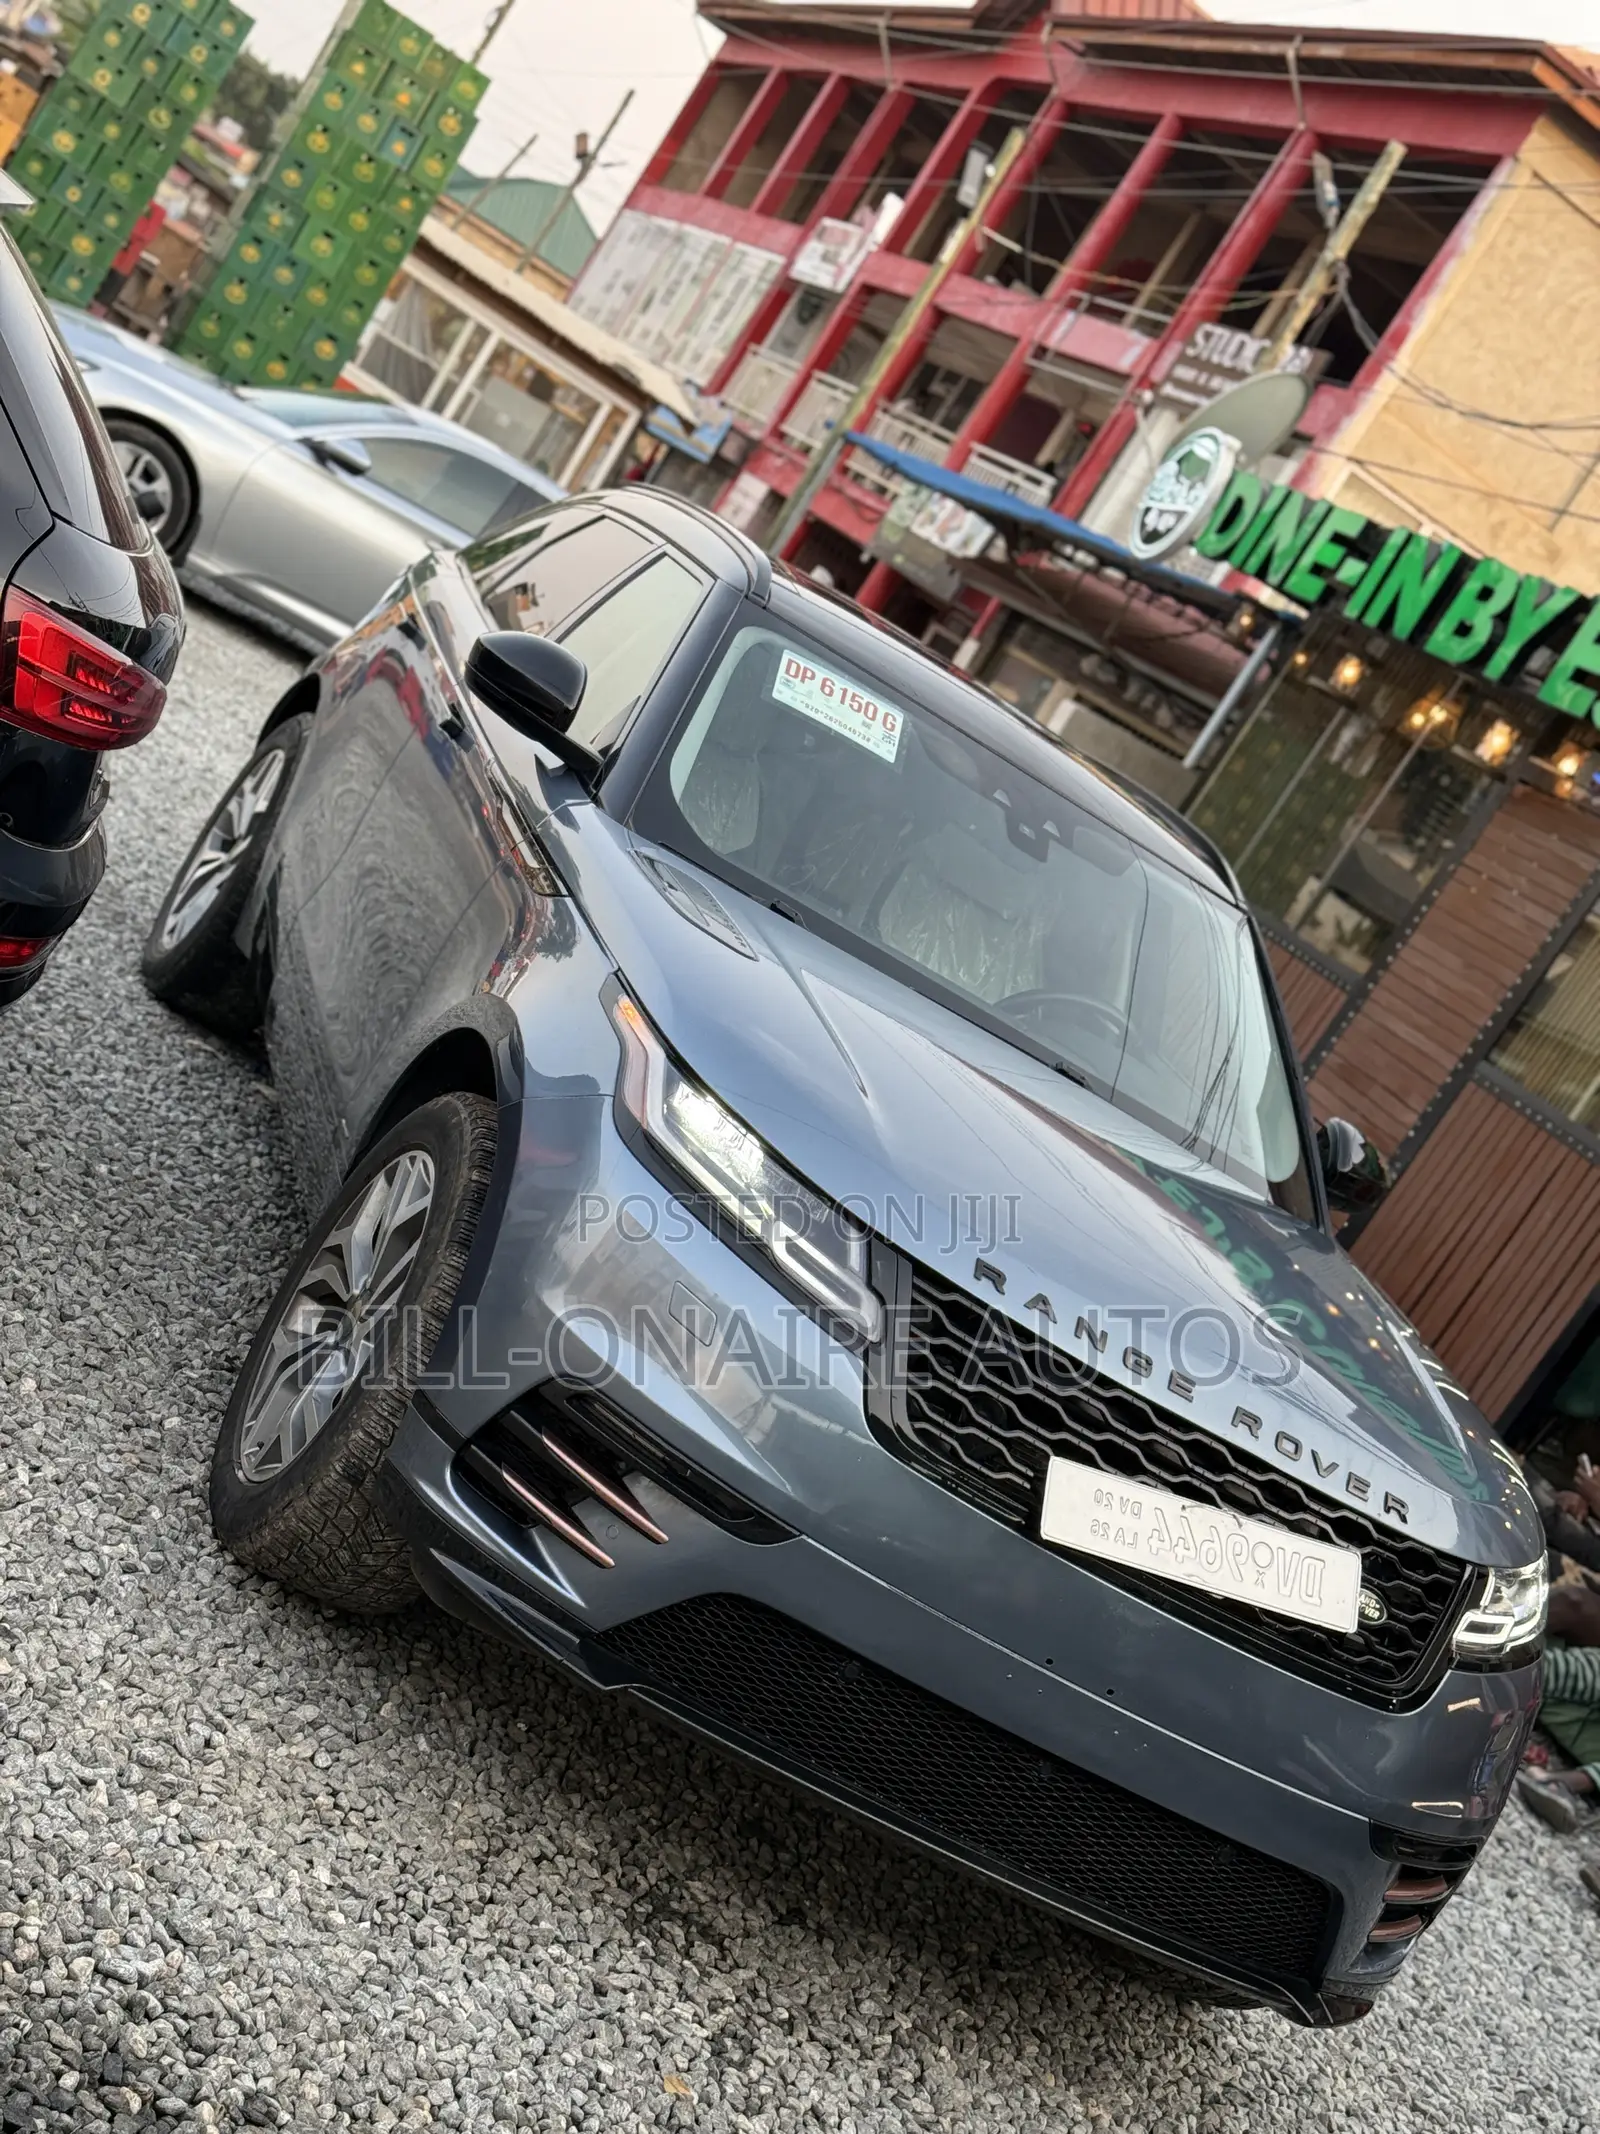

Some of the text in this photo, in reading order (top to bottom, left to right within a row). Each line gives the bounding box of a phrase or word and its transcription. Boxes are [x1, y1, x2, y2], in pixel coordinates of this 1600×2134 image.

[1195, 470, 1462, 641] DINE-IN
[1423, 557, 1581, 681] BY
[784, 658, 816, 684] DP
[820, 677, 879, 721] 6150
[882, 711, 897, 732] G
[974, 1257, 1196, 1403] RANGE
[1231, 1405, 1410, 1525] ROVER
